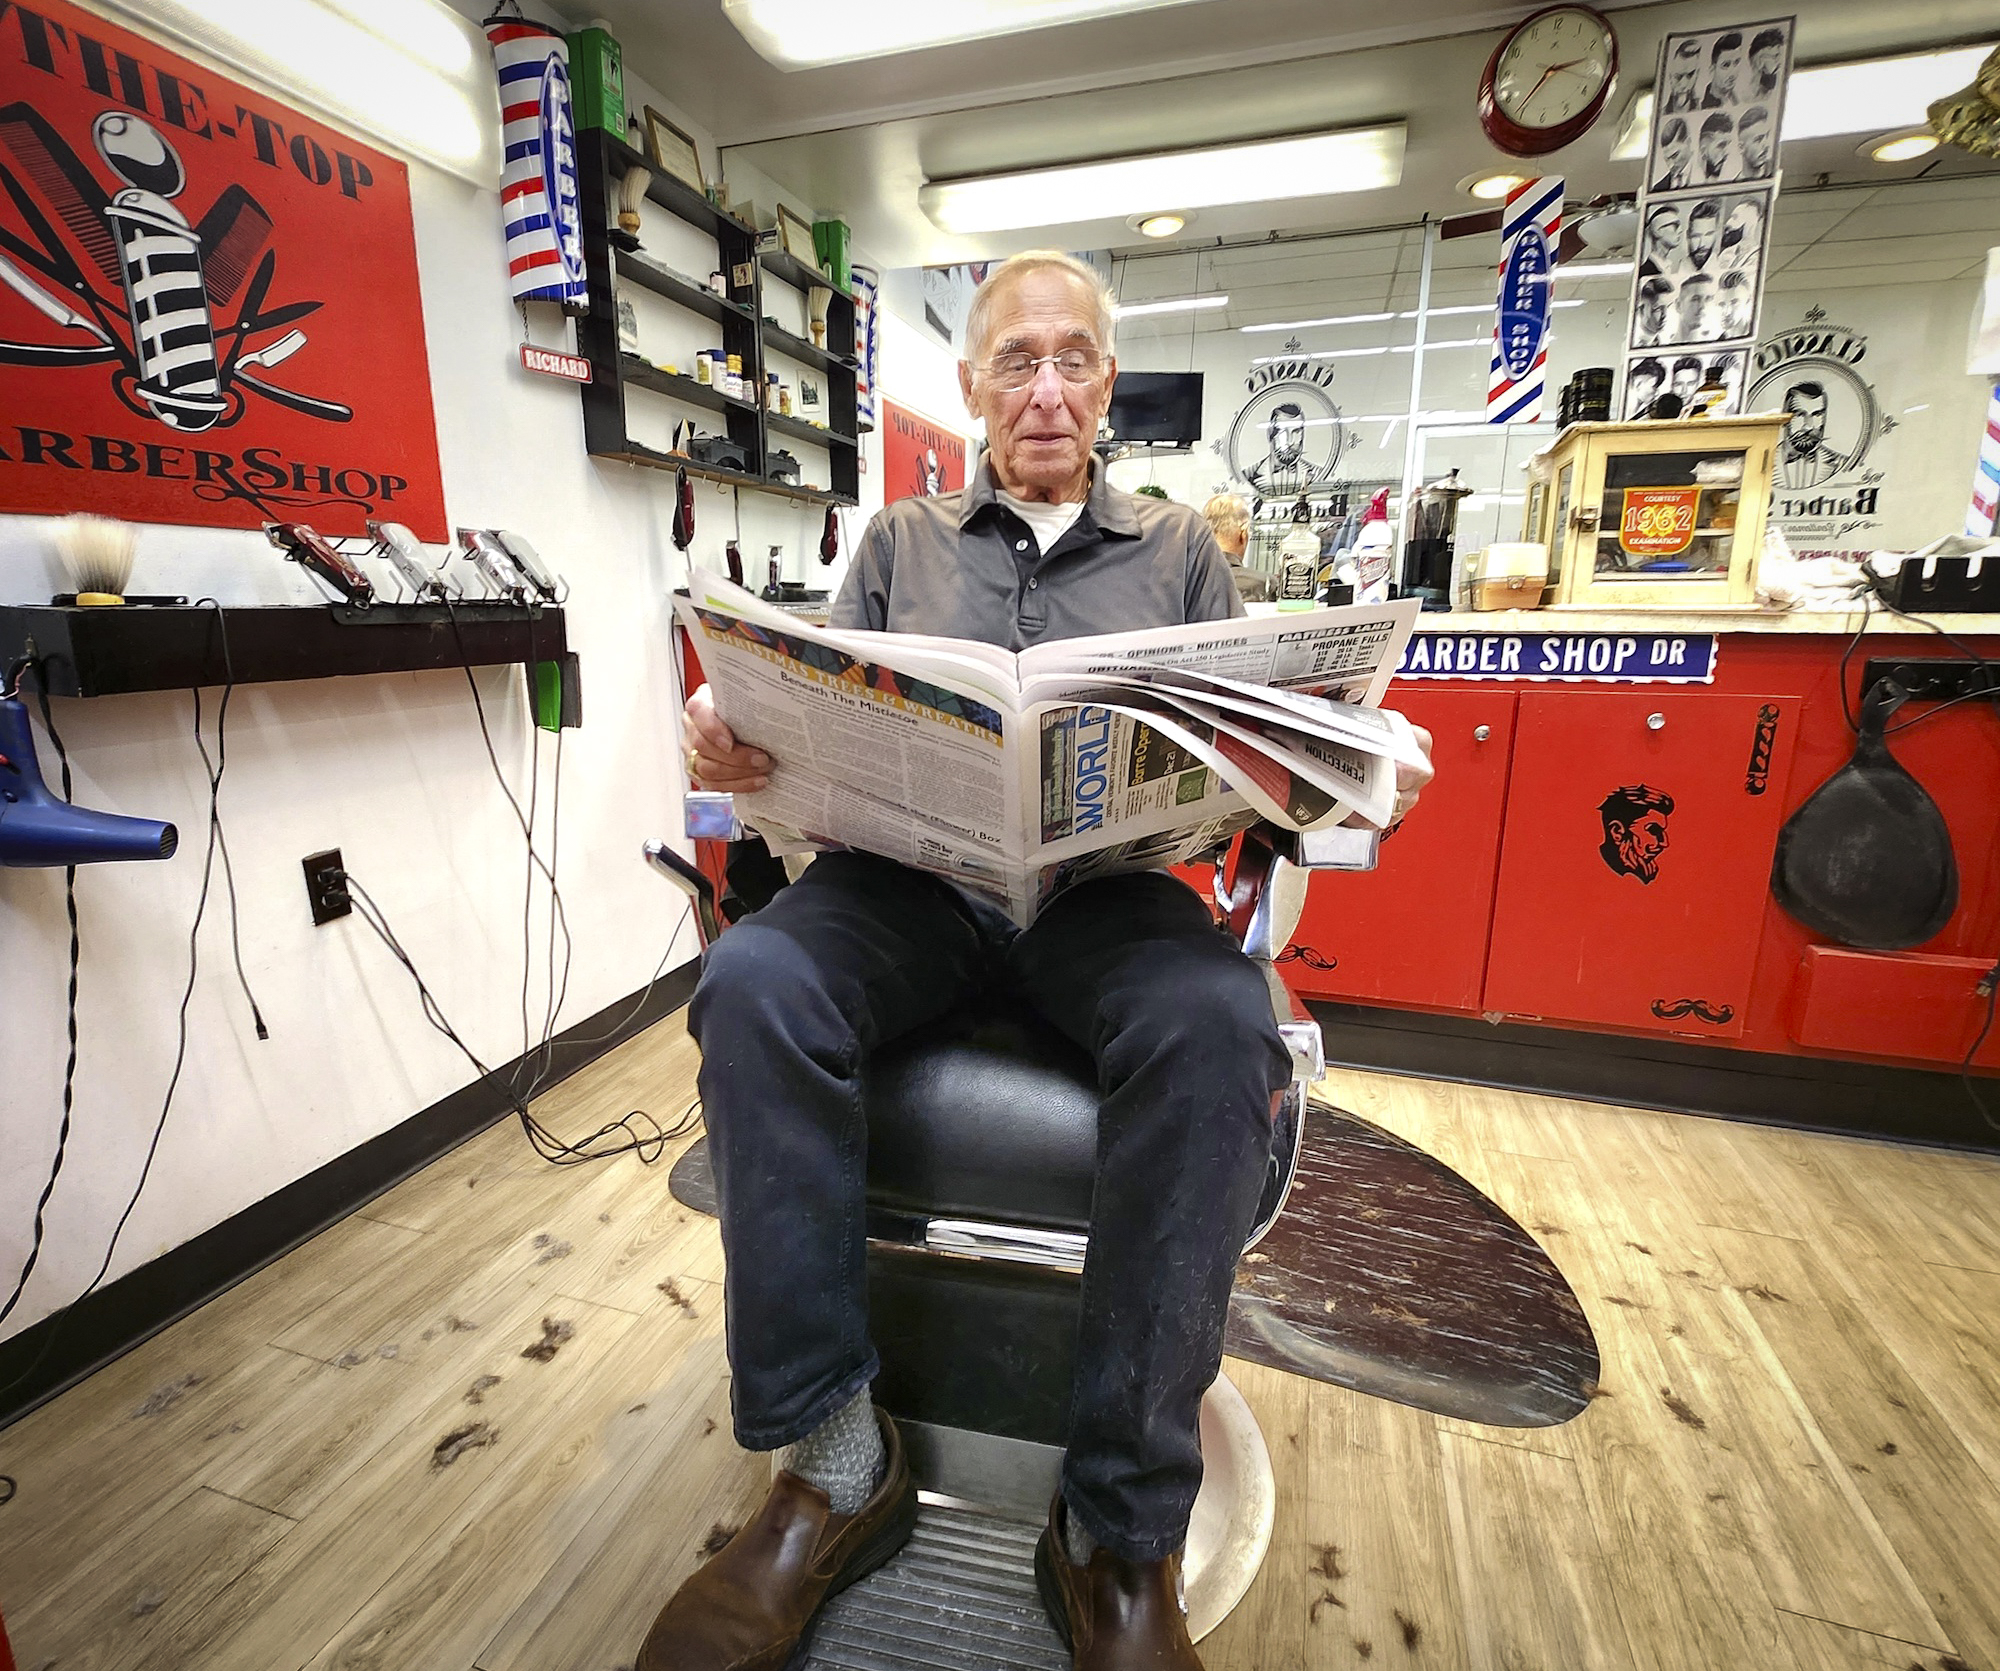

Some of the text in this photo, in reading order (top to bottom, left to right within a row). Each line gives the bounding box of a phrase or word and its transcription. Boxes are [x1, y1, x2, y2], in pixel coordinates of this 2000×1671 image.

[1514, 234, 1541, 311] BARBER
[1508, 322, 1531, 374] SHOP
[524, 349, 588, 379] RICHARD
[1625, 505, 1694, 533] 1962
[1311, 633, 1388, 651] PROPANE FILLS
[1353, 621, 1393, 633] LAND
[1127, 644, 1184, 659] OPINIONS
[1196, 637, 1248, 651] NOTICES
[1397, 636, 1687, 672] ARBER SHOP DR
[711, 630, 809, 678] CHRISTMAS
[815, 672, 875, 701] TREES
[882, 694, 896, 706] &
[903, 700, 998, 744] WREATHS
[780, 671, 829, 699] Beneath
[831, 691, 855, 705] The
[1075, 705, 1111, 835] WORLD
[1131, 755, 1146, 786] Barre
[1163, 760, 1176, 775] Dec
[1305, 742, 1365, 784] PERFECTION
[979, 831, 1003, 843] Box
